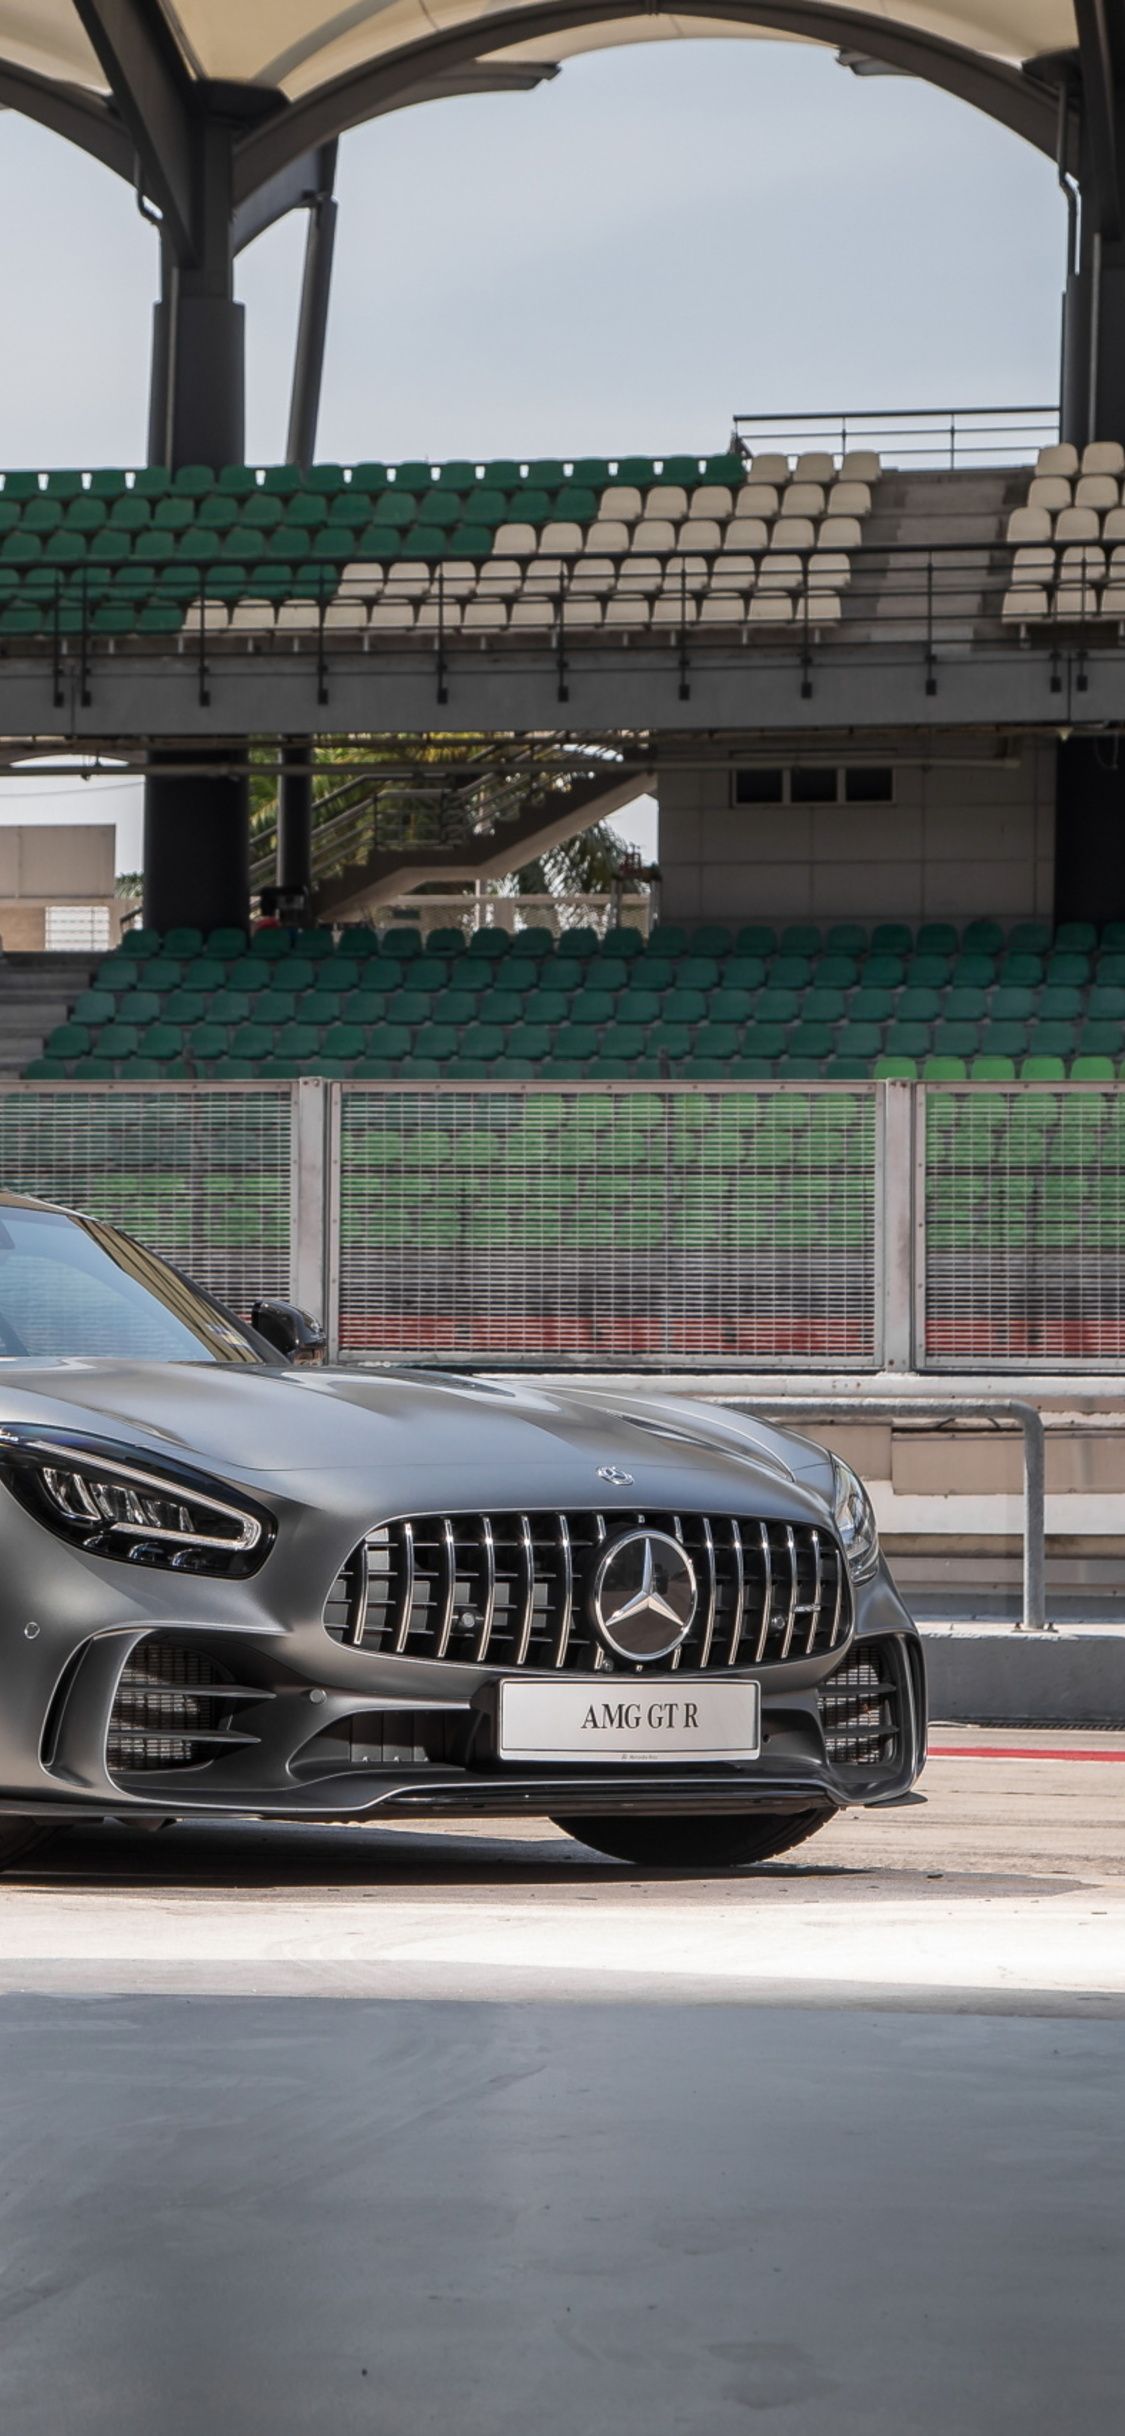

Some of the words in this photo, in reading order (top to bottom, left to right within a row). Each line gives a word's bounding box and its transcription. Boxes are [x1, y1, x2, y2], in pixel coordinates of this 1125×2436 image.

[580, 1703, 642, 1729] AMG
[647, 1702, 679, 1729] GT
[683, 1702, 699, 1728] R
